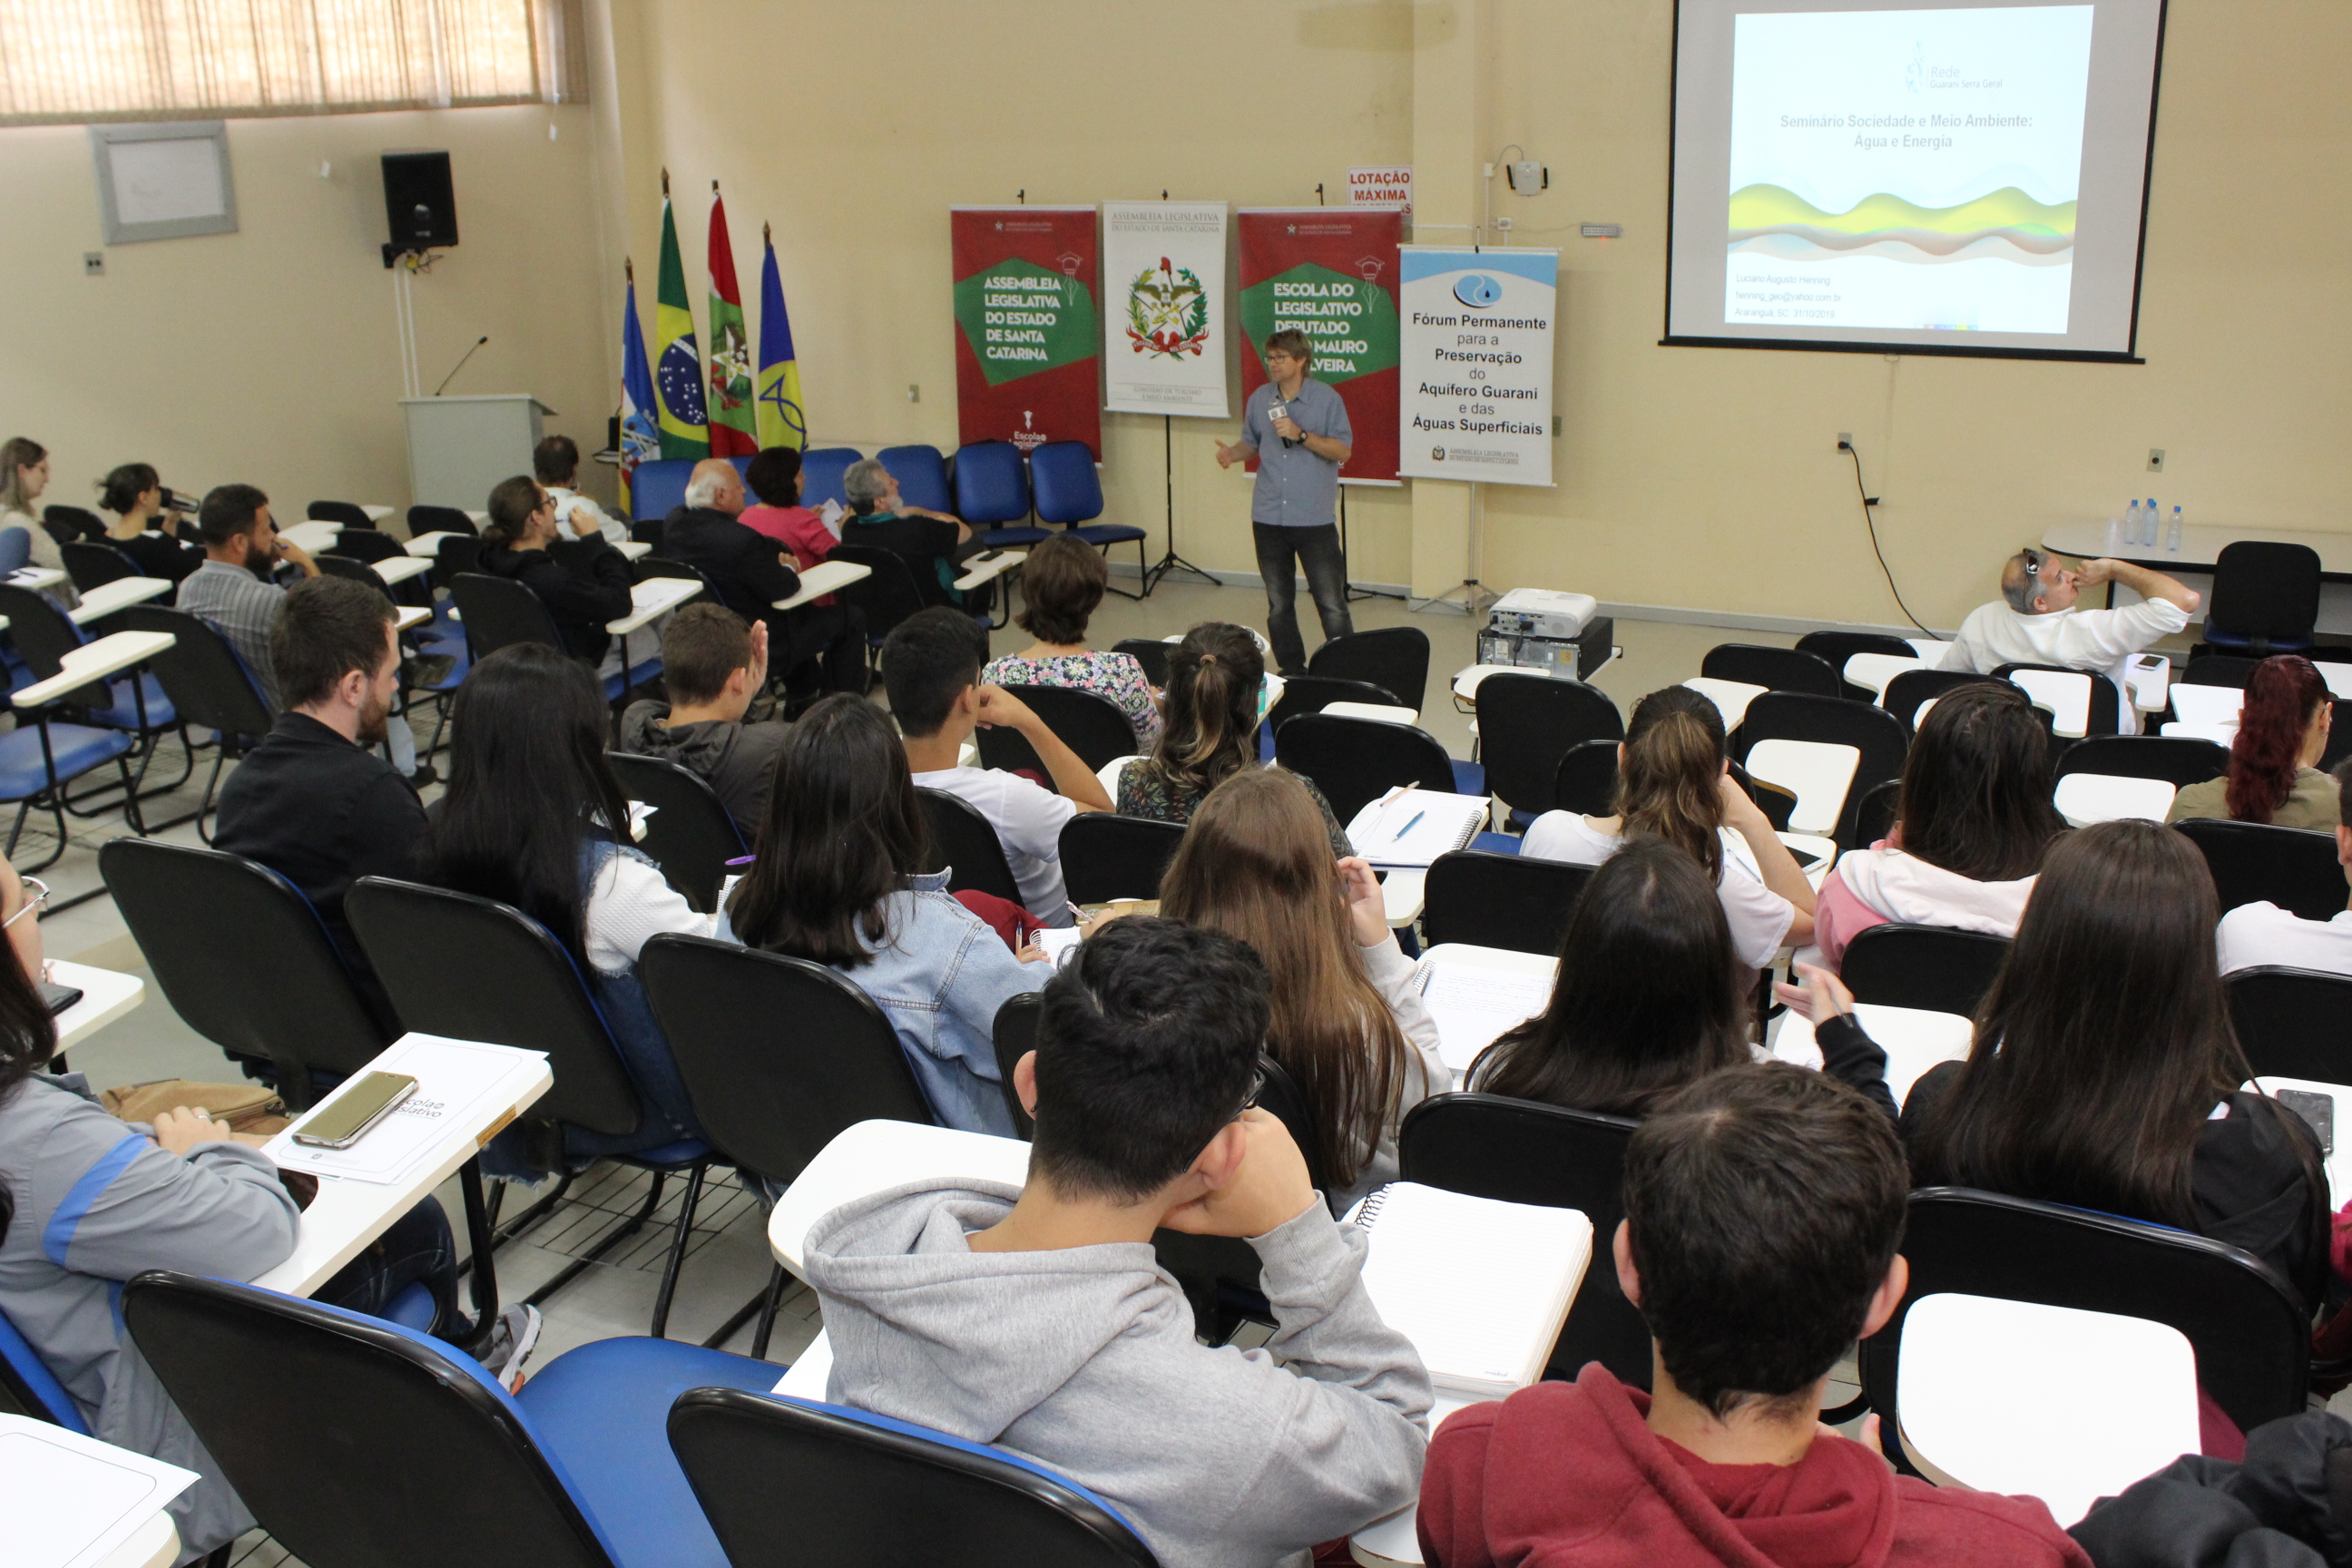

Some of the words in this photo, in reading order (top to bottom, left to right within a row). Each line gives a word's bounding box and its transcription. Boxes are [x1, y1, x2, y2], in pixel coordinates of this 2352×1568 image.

[1931, 65, 1960, 78] Rede
[1930, 80, 1959, 89] Guarani
[1961, 79, 1980, 88] Serra
[1982, 78, 2003, 88] Geral
[1780, 114, 1844, 128] Seminário
[1847, 114, 1915, 128] Sociedade
[1918, 118, 1926, 128] e
[1930, 114, 1962, 127] Meio
[1965, 113, 2033, 127] Ambiente:
[1854, 131, 1887, 150] Água
[1891, 138, 1899, 148] e
[1903, 134, 1953, 151] Energia
[1350, 171, 1410, 186] LOTAÇÃO
[1355, 188, 1406, 201] MÁXIMA
[1112, 211, 1162, 221] ASSEMBLEIA
[1165, 212, 1220, 222] LEGISLATIVA
[984, 276, 1062, 290] ASSEMBLEIA
[1736, 273, 1765, 283] Luciano
[1766, 275, 1797, 285] Augusto
[1799, 275, 1830, 287] Henning
[1274, 283, 1329, 297] ESCOLA
[1331, 283, 1355, 298] DO
[985, 294, 1061, 309] LEGISLATIVA
[1274, 301, 1363, 316] LEGISLATIVO
[985, 311, 1005, 325] DO
[1006, 311, 1056, 326] ESTADO
[1413, 312, 1456, 327] Fórum
[1462, 314, 1546, 329] Permanente
[986, 328, 1003, 342] DE
[1004, 329, 1045, 343] SANTA
[1457, 334, 1486, 347] para
[1491, 336, 1499, 346] a
[986, 346, 1048, 361] CATARINA
[1314, 339, 1367, 354] MAURO
[1436, 348, 1522, 366] Preservação
[1469, 368, 1485, 380] do
[1419, 382, 1477, 397] Aquífero
[1482, 385, 1538, 399] Guarani
[1459, 404, 1467, 414] e
[1471, 402, 1494, 415] das
[1413, 413, 1455, 431] Águas
[1460, 418, 1543, 435] Superficiais
[1014, 431, 1041, 441] Escola
